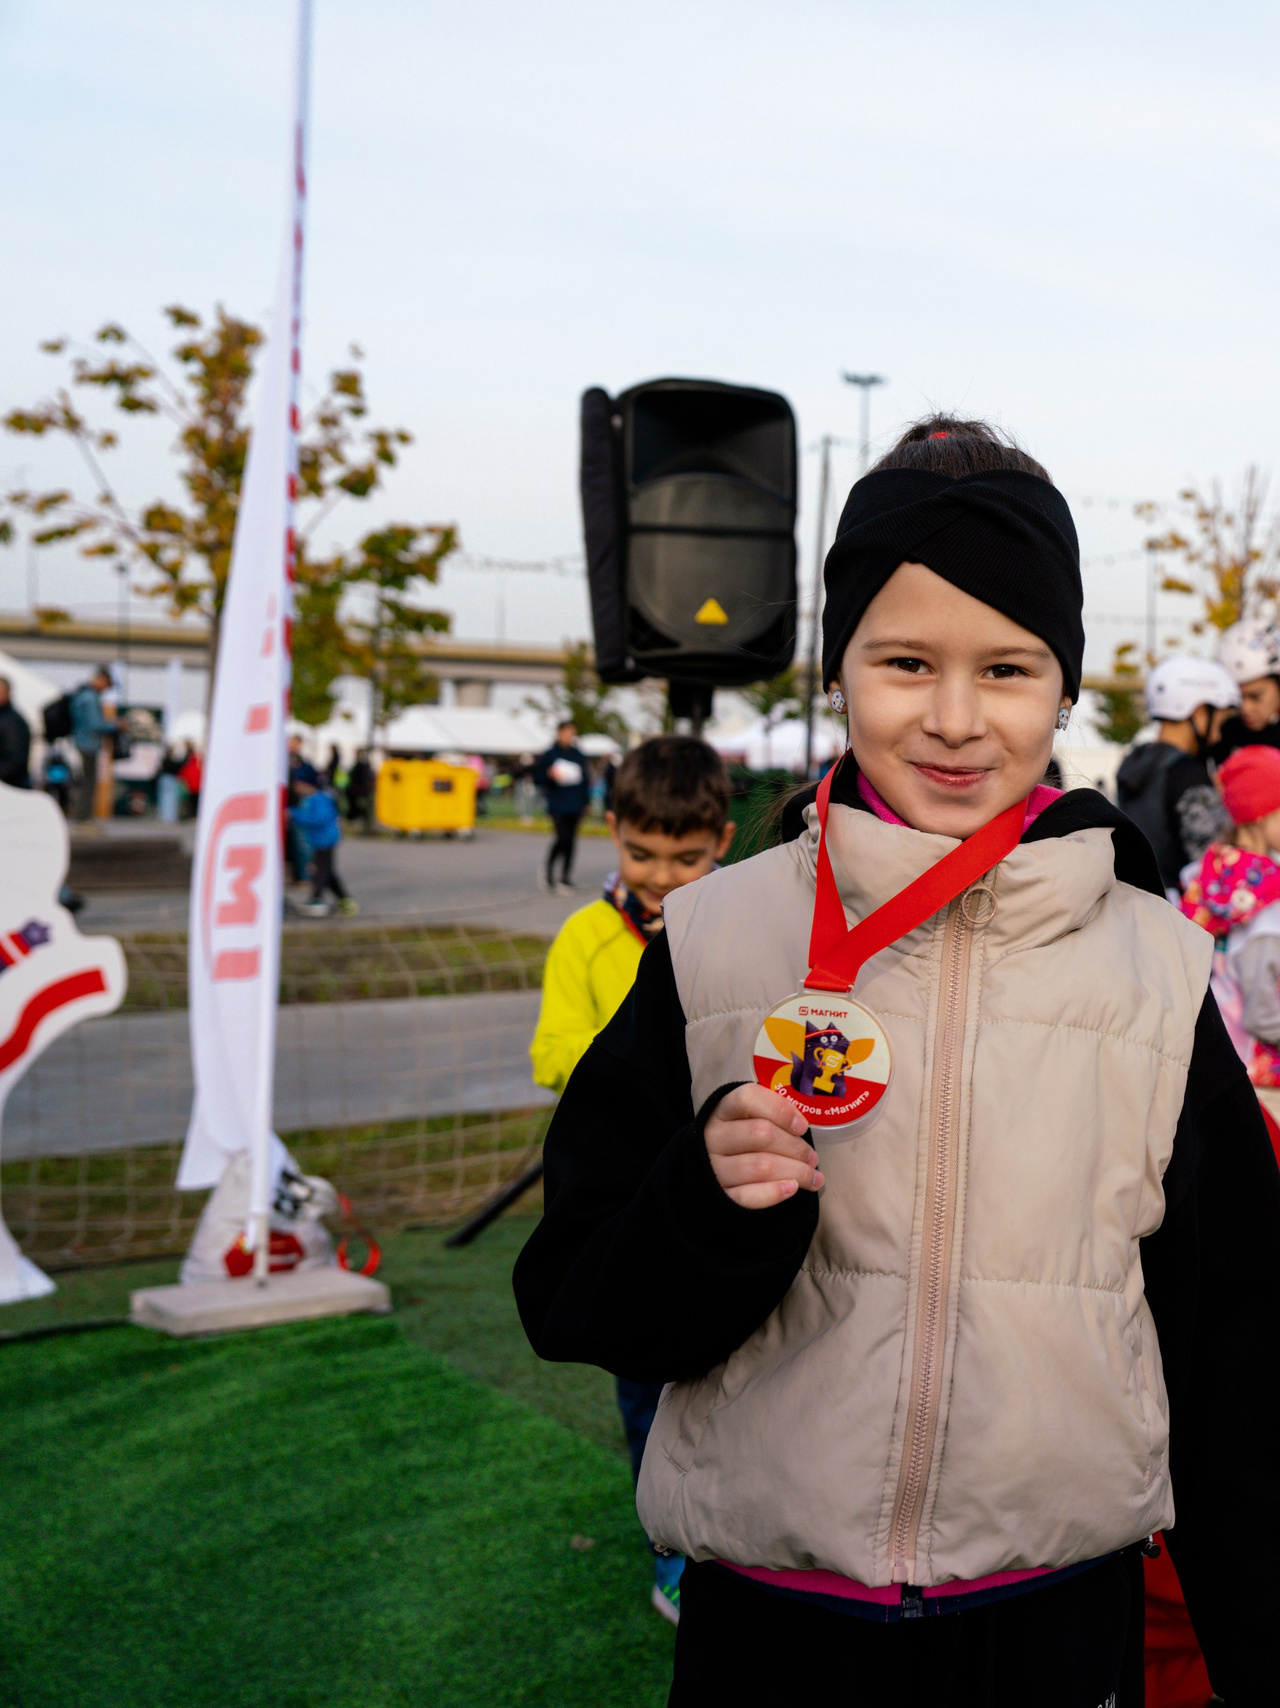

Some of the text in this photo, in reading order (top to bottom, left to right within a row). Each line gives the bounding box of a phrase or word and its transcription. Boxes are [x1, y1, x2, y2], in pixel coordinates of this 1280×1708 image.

[810, 1008, 848, 1018] МАГНИТ
[786, 1095, 822, 1116] метров
[824, 1090, 870, 1116] «Магнит»
